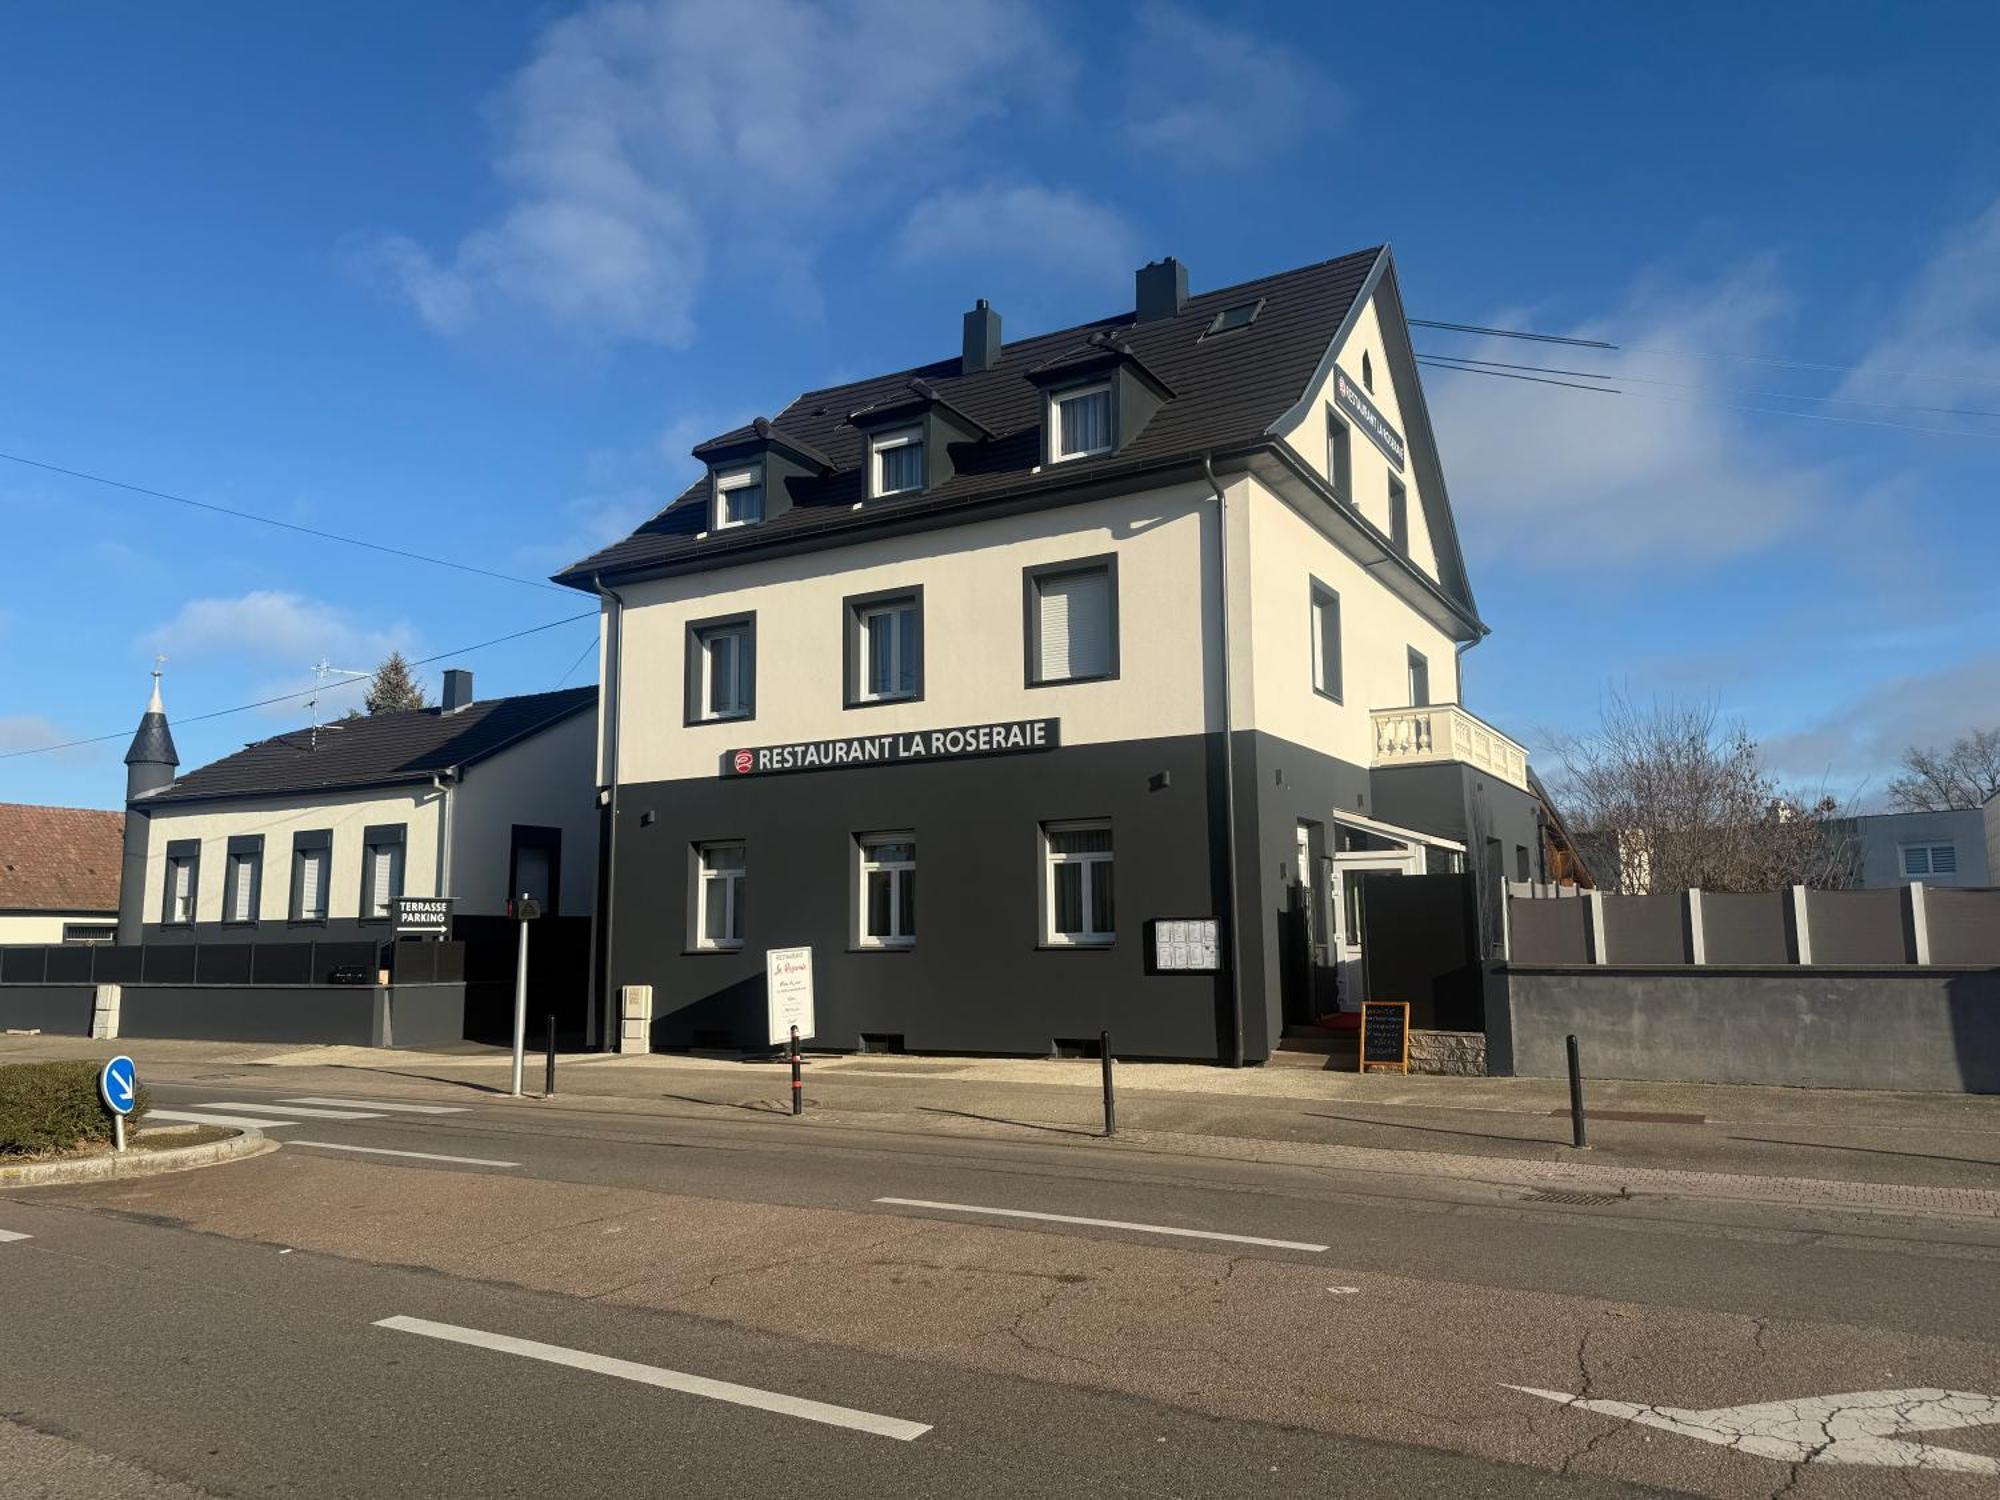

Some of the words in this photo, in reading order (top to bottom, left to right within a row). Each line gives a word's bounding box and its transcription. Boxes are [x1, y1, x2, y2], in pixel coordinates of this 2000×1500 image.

[759, 737, 893, 770] RESTAURANT
[899, 734, 928, 758] LA
[931, 722, 1046, 753] ROSERAIE
[400, 902, 447, 911] TERRASSE
[401, 913, 445, 923] PARKING
